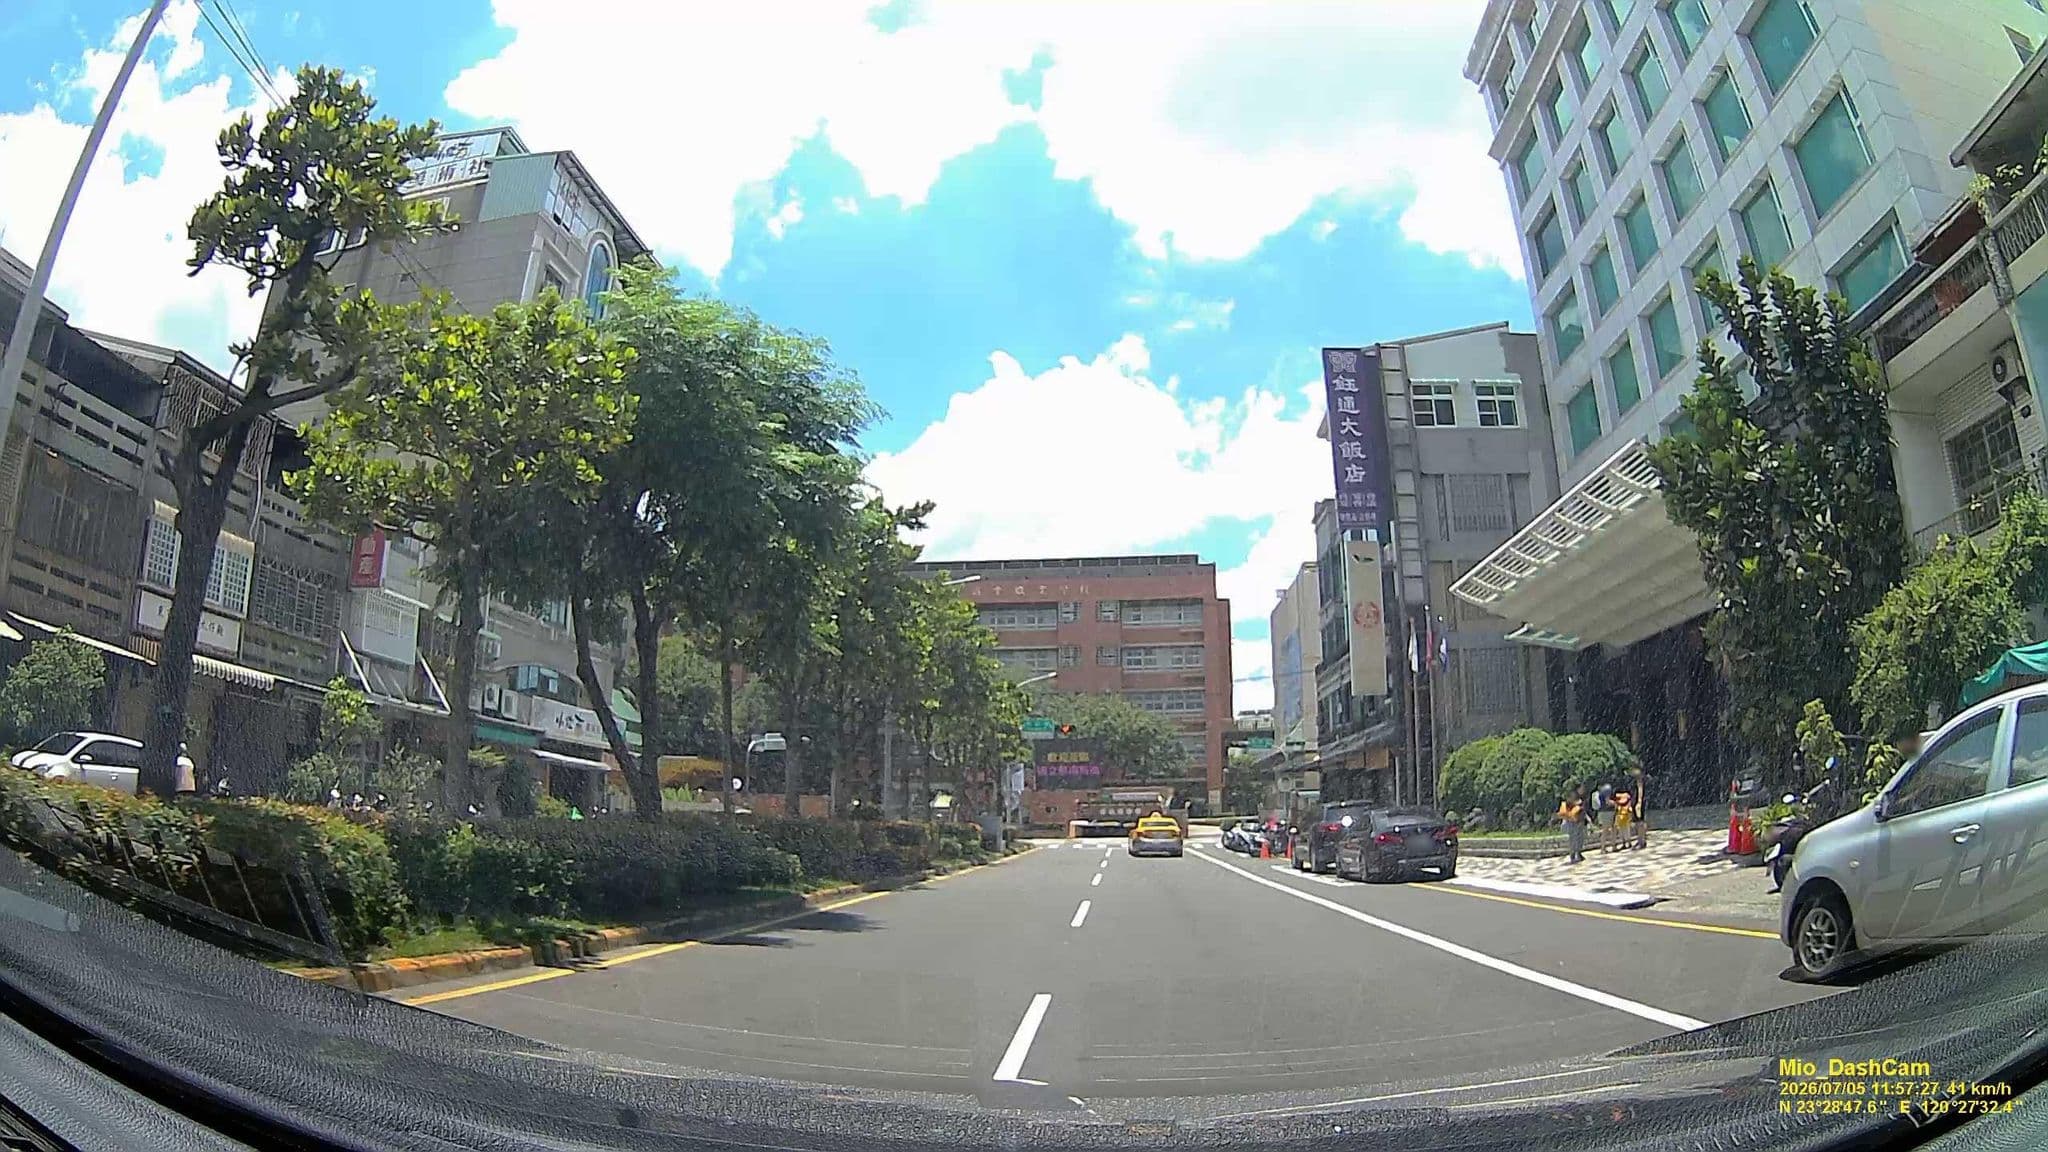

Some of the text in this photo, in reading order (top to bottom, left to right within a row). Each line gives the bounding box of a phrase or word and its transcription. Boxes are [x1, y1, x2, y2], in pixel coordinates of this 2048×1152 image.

[1332, 374, 1367, 483] 鈺通大飯店
